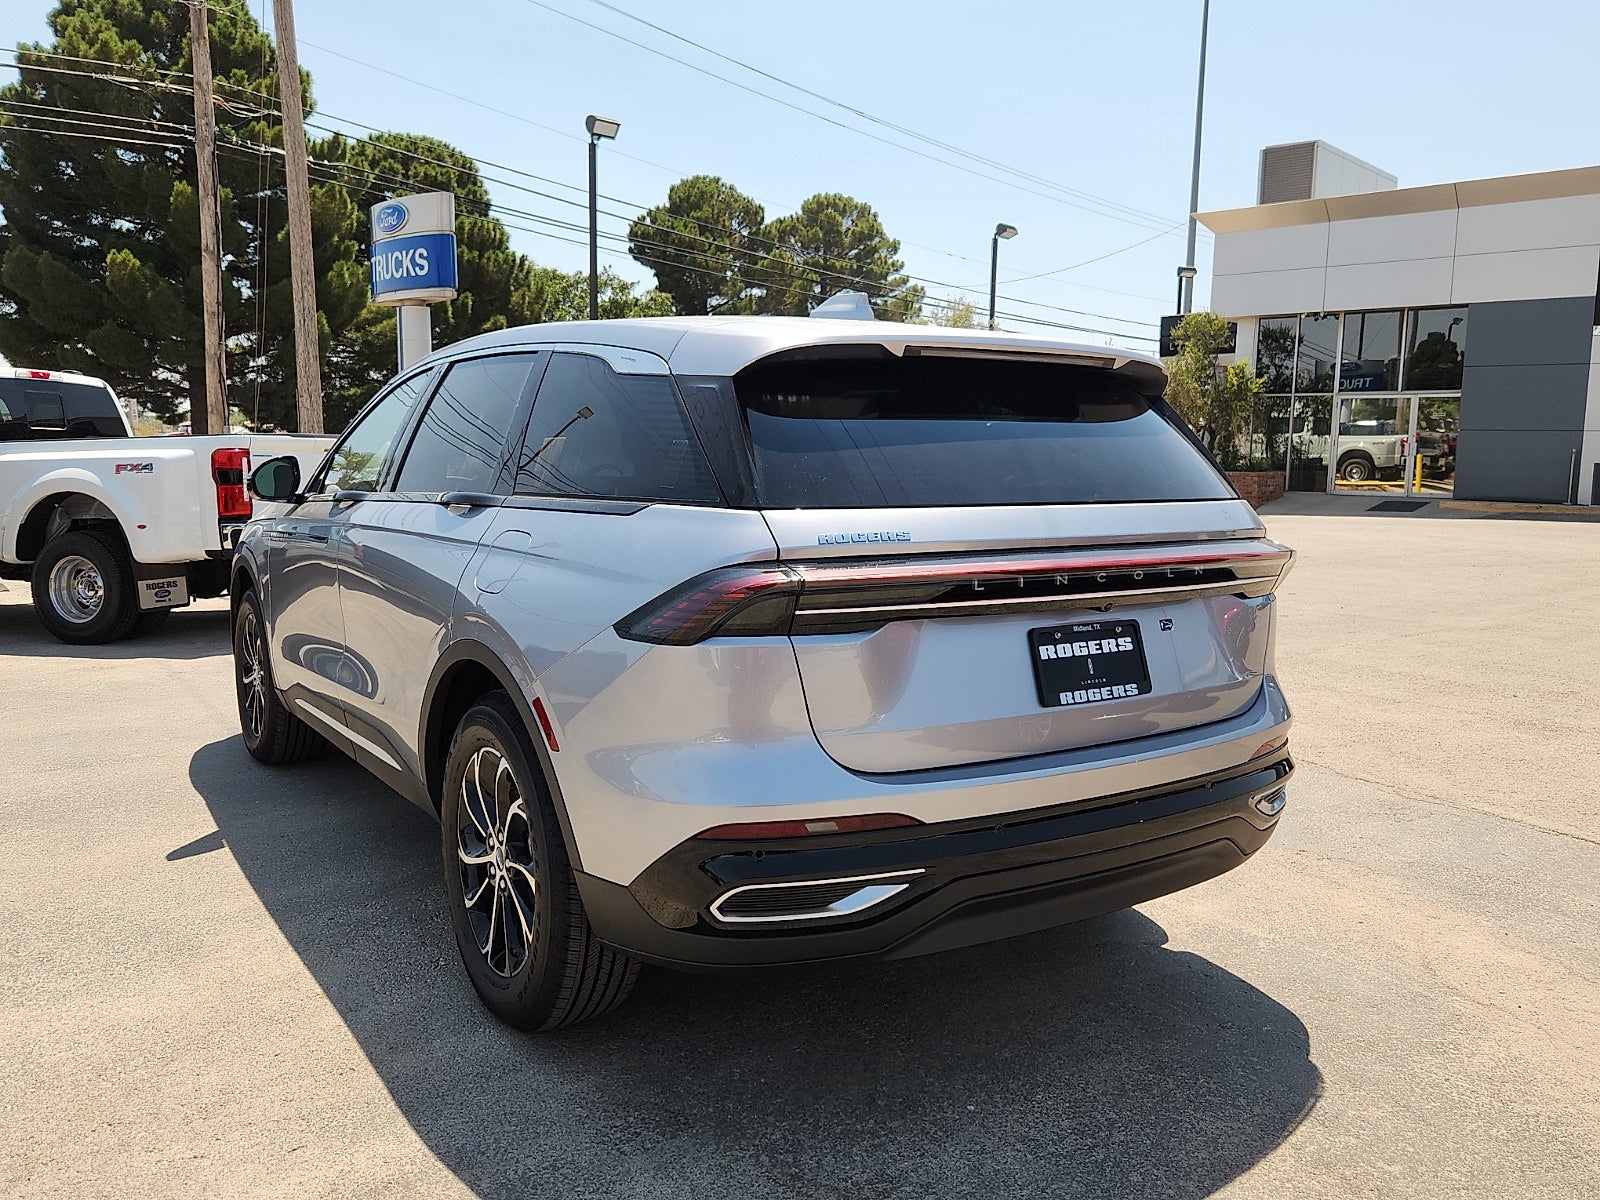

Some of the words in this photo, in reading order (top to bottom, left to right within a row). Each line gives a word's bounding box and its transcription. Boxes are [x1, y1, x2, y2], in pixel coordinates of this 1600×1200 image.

[380, 208, 398, 228] Ford
[370, 248, 429, 283] TRUCKS
[115, 463, 154, 474] FX4
[817, 530, 912, 545] ROGERS
[146, 580, 178, 591] ROGERS
[973, 565, 1204, 591] LINCOLN
[1073, 624, 1094, 632] Midland,
[1038, 636, 1134, 660] ROGERS
[1059, 683, 1139, 705] ROGERS
